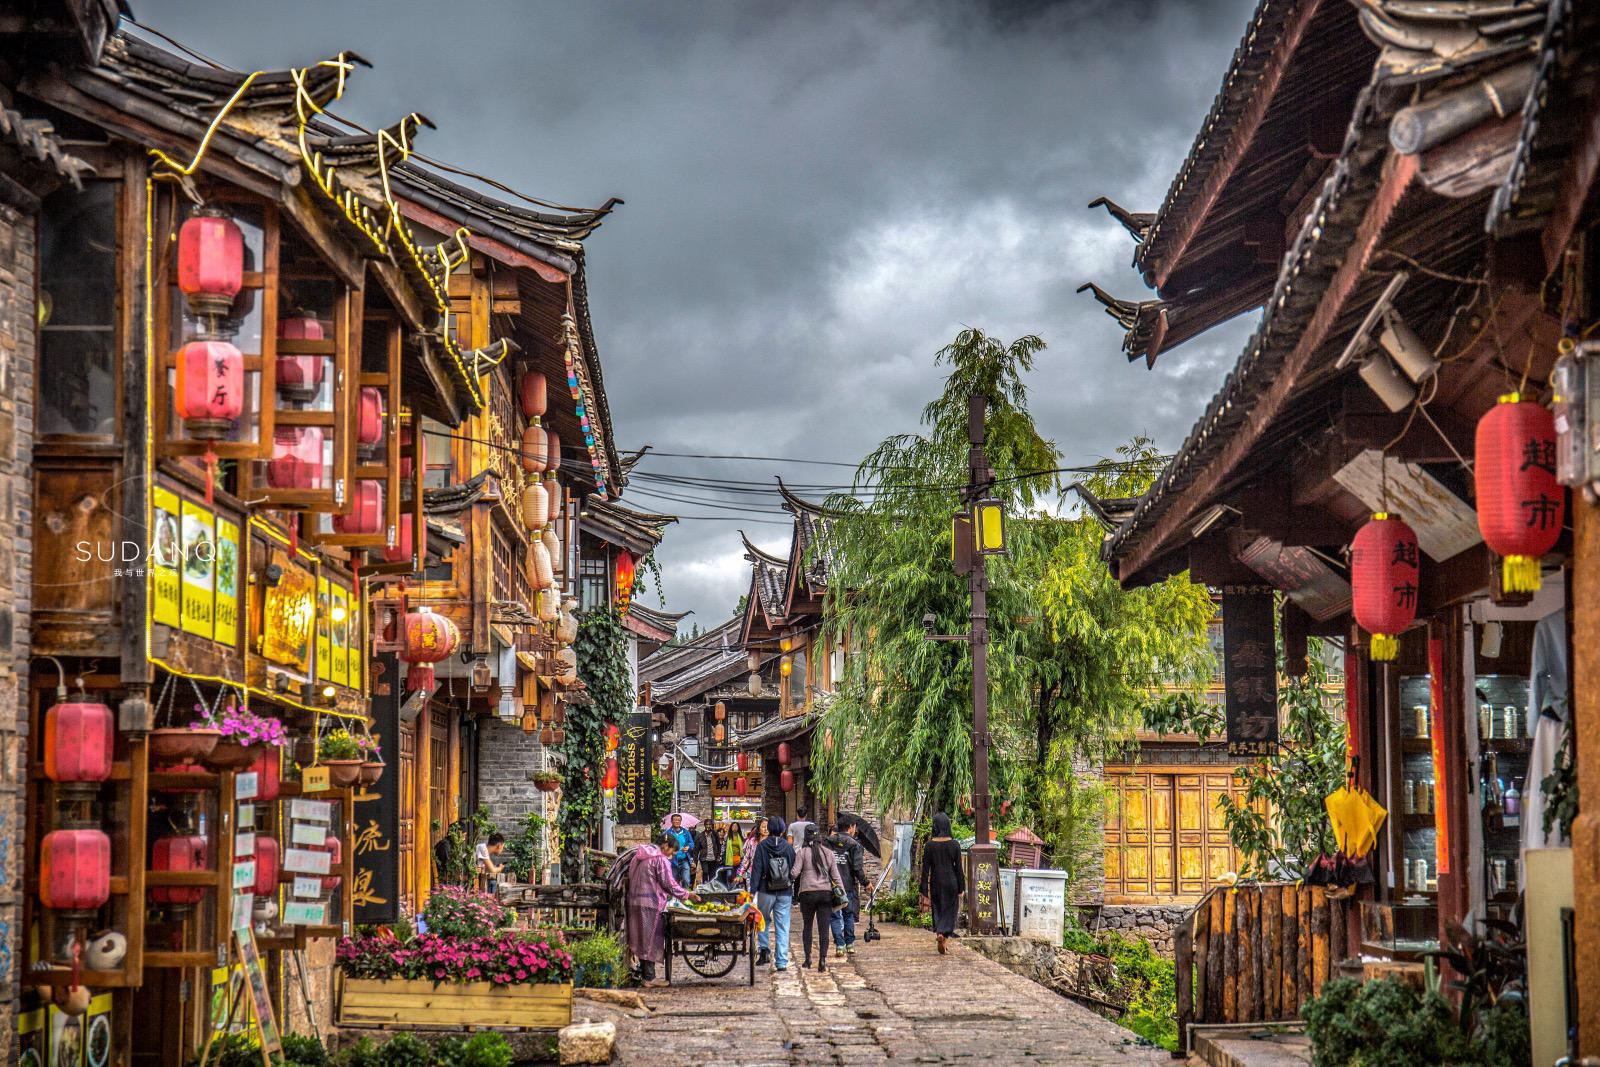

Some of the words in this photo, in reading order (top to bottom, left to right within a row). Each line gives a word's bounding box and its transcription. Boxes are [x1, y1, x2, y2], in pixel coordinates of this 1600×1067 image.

[1521, 437, 1559, 530] 超市
[1391, 540, 1418, 610] 超市
[625, 742, 640, 814] Compass
